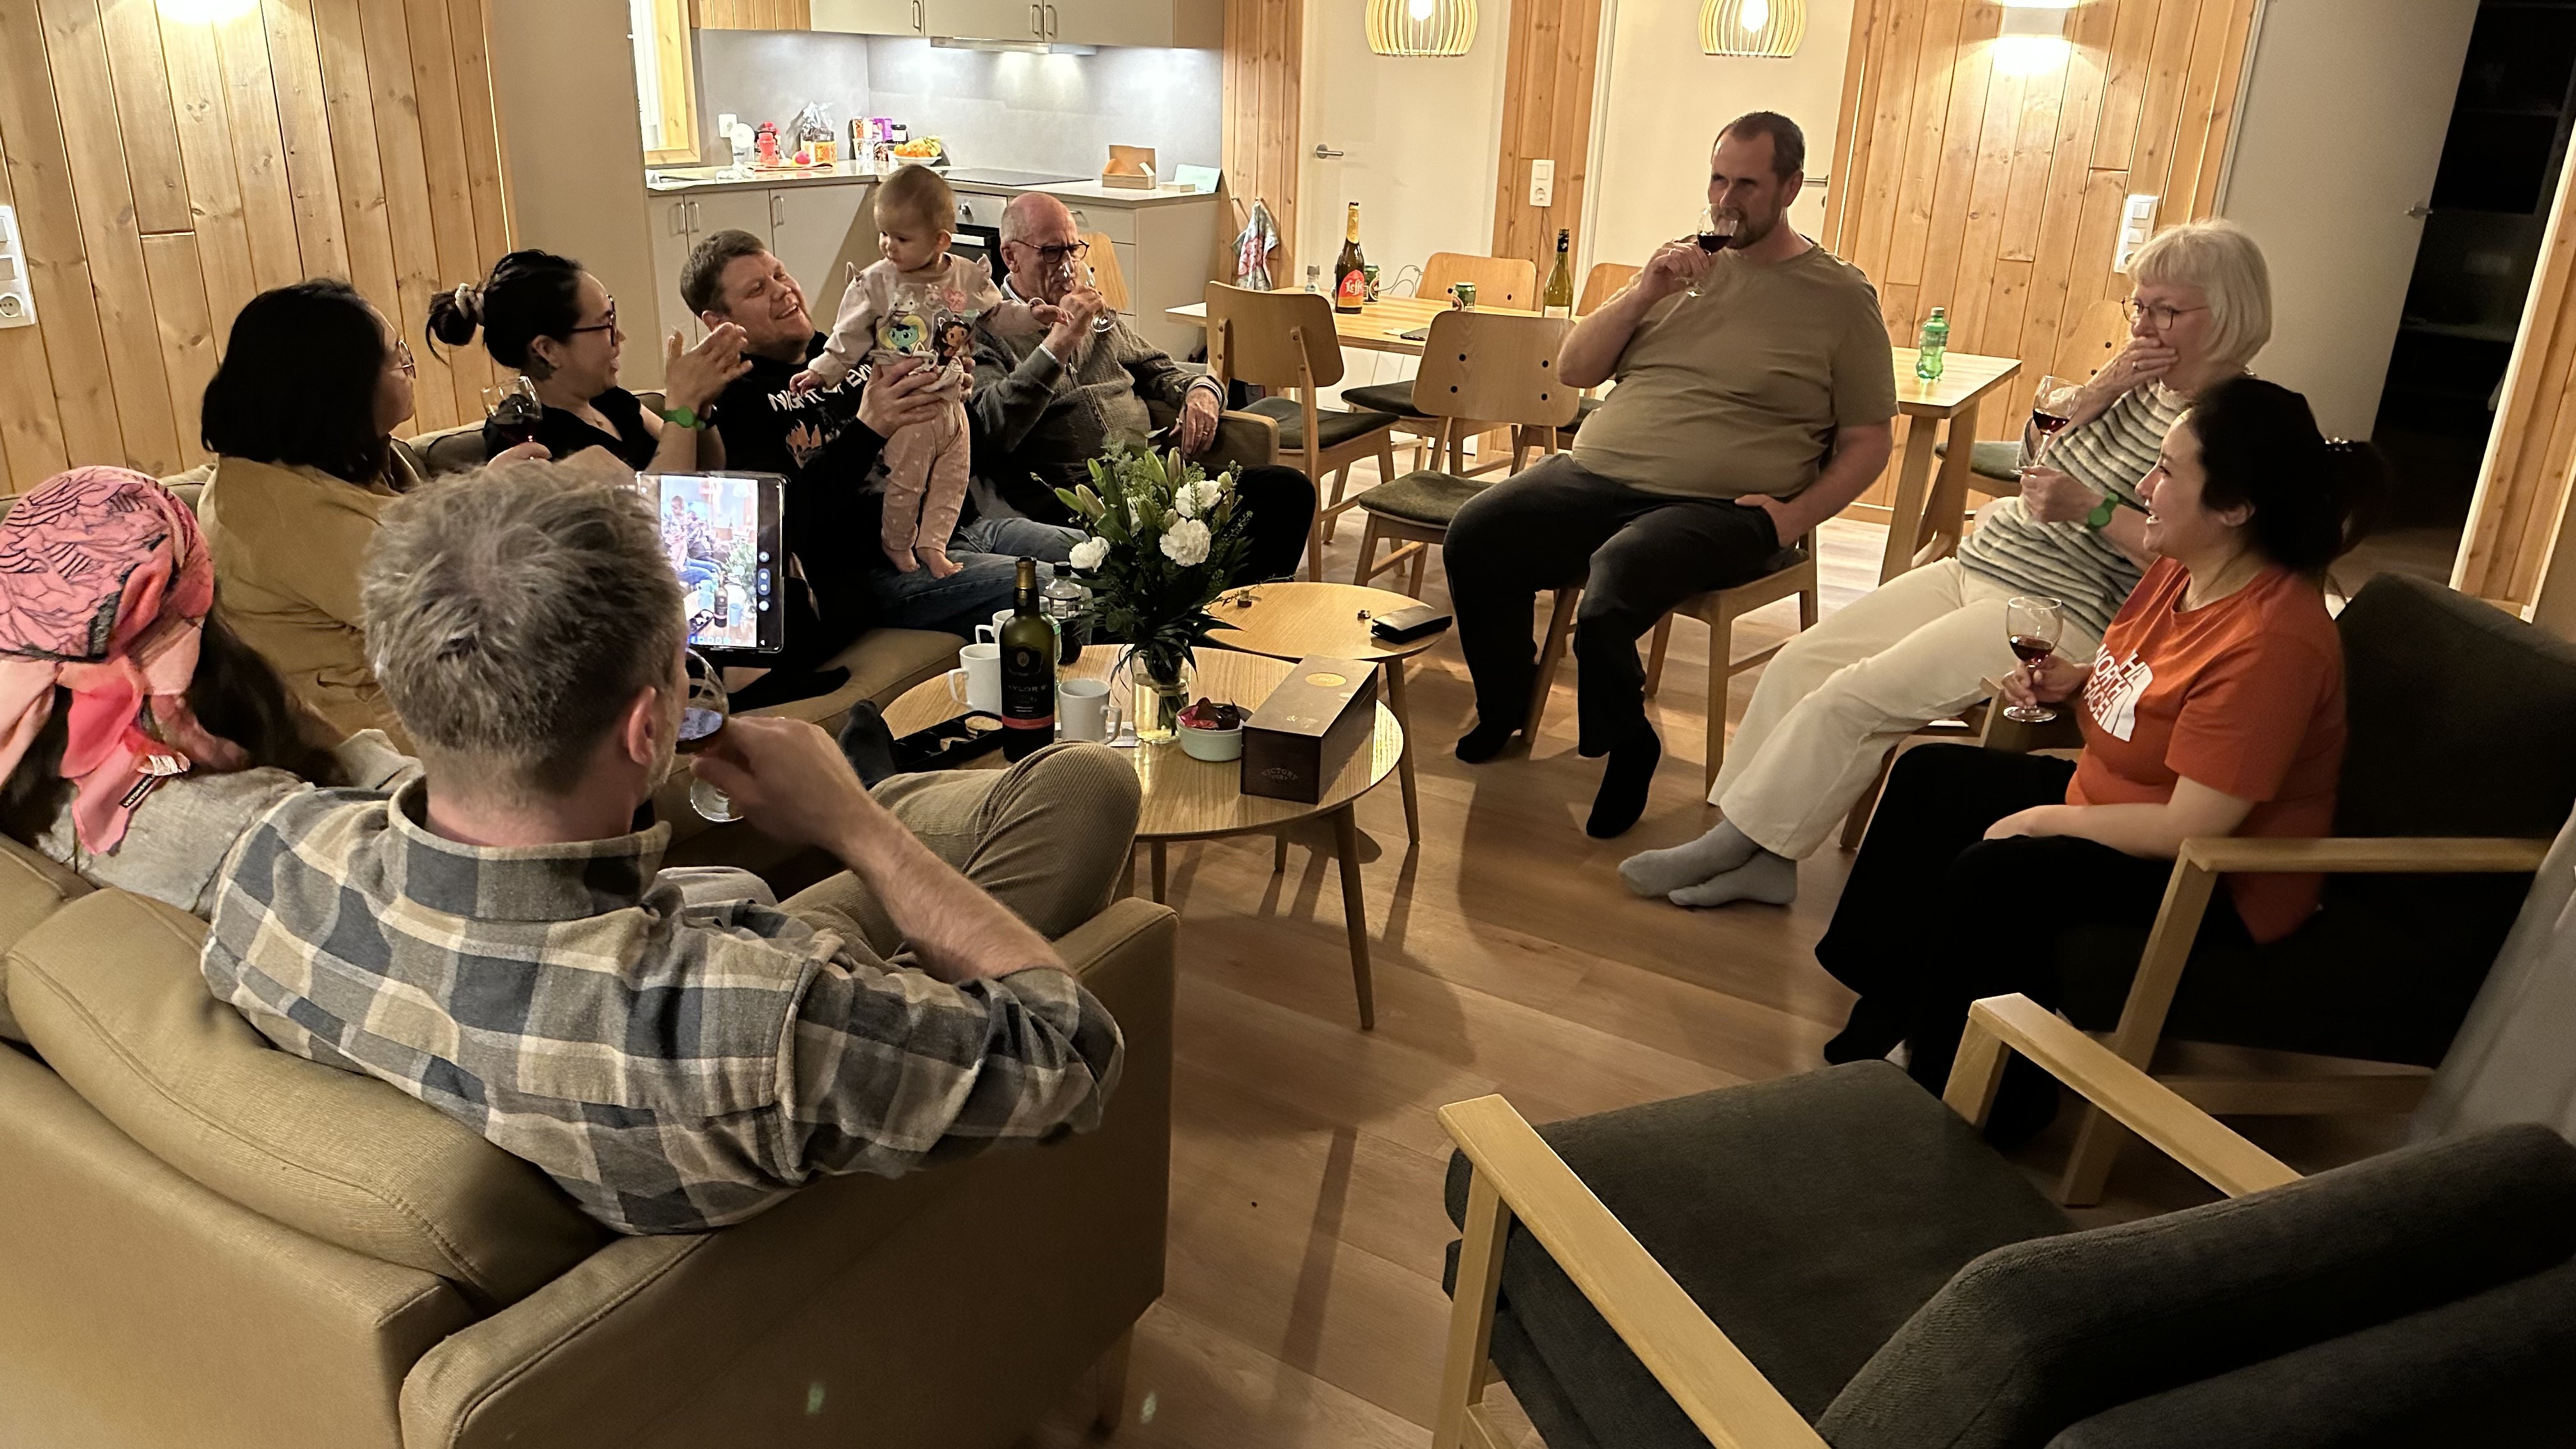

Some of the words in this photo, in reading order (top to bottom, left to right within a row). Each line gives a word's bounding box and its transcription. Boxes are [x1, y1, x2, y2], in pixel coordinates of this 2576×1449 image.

[2094, 643, 2128, 702] NORTH
[2083, 674, 2111, 721] FACE
[1261, 767, 1299, 781] VICTORY
